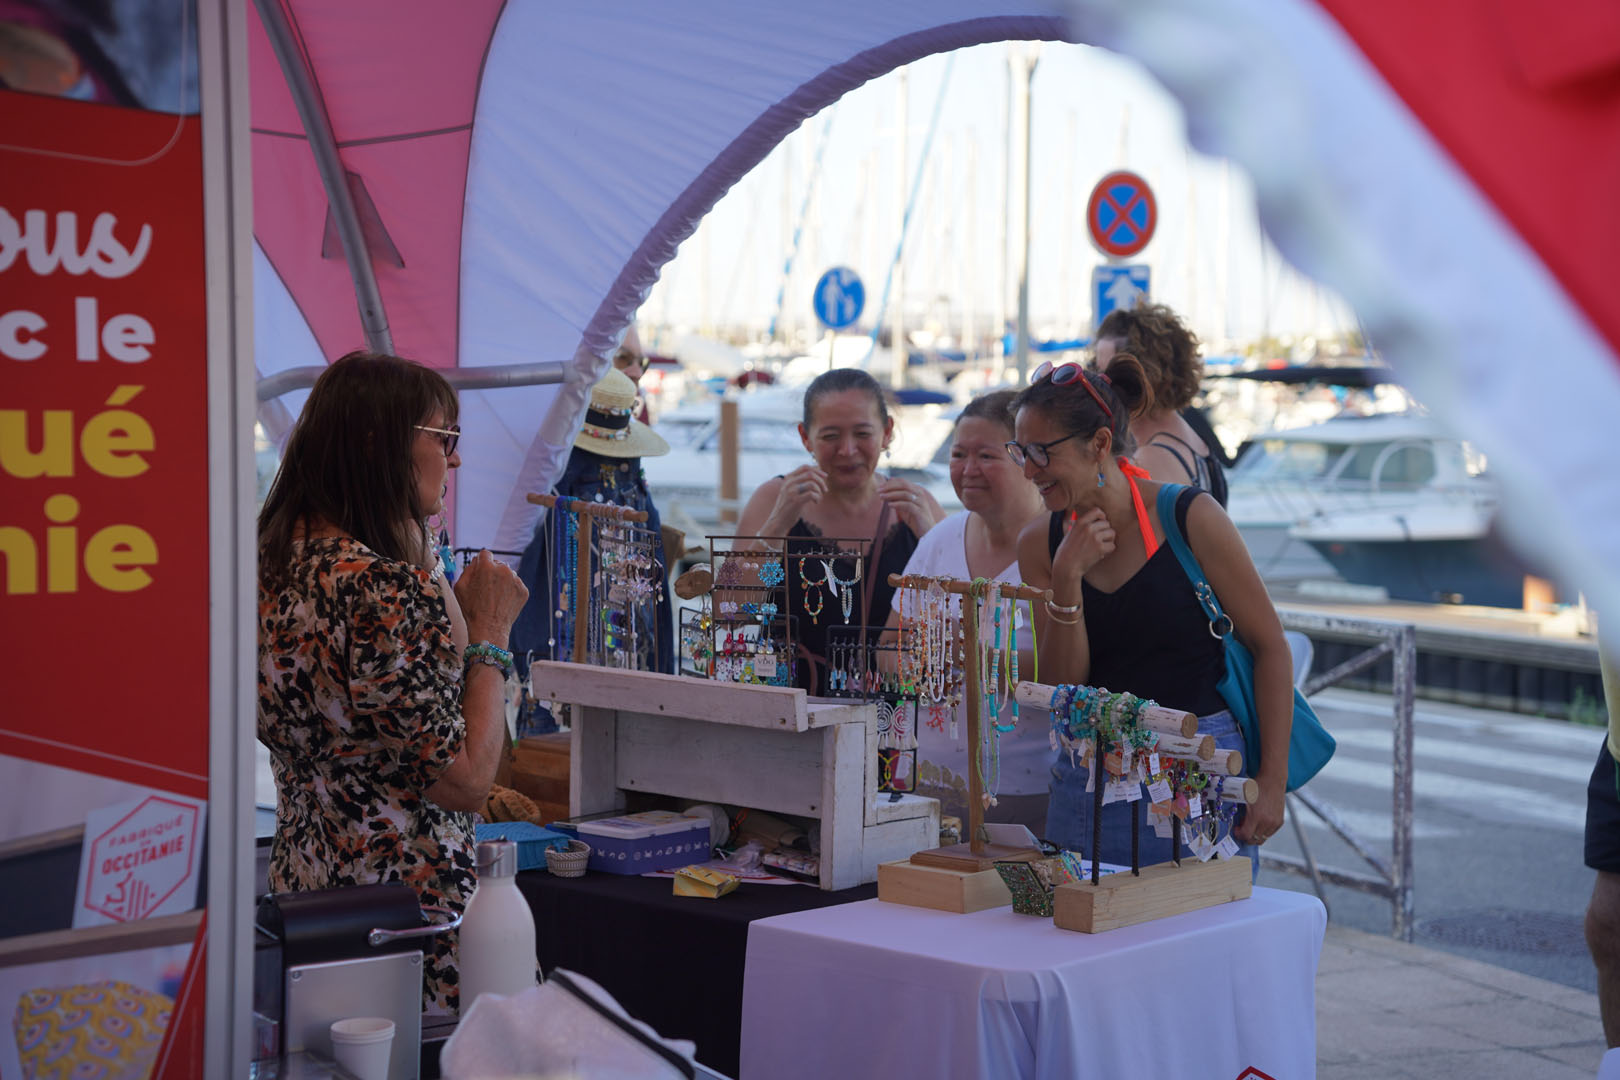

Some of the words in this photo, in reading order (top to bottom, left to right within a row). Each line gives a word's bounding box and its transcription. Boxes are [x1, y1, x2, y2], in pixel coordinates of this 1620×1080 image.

[75, 297, 156, 363] le
[0, 385, 156, 478] ué
[102, 834, 185, 876] OCCITANIE
